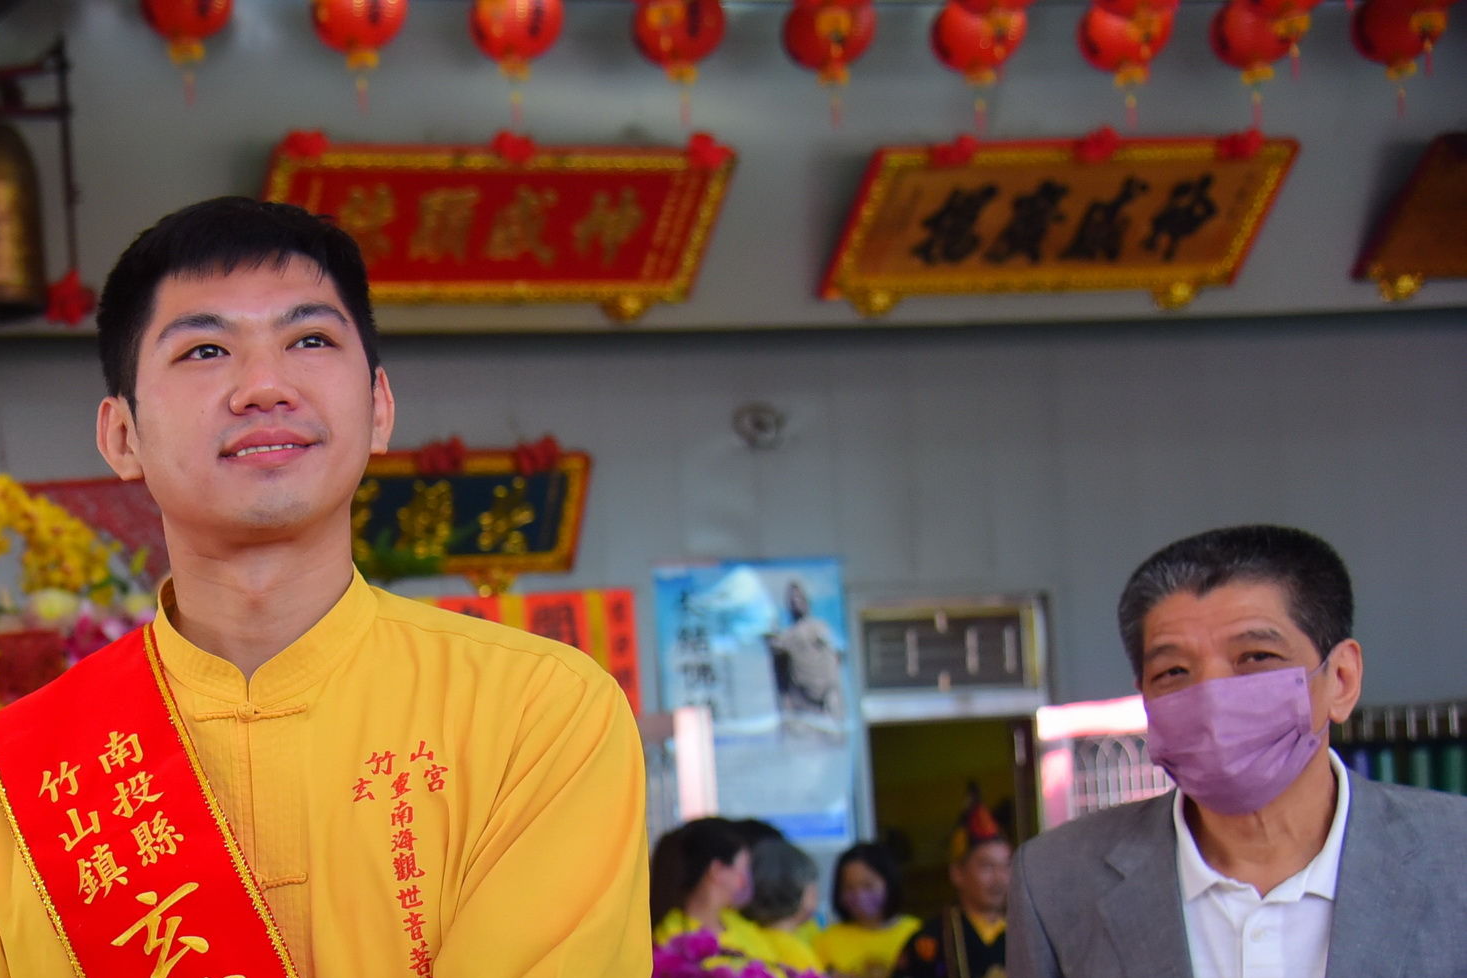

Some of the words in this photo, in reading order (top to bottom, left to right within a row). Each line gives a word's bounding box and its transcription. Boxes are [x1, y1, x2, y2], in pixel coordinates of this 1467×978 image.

[38, 760, 129, 905] 竹山鎮
[97, 730, 185, 868] 南投縣
